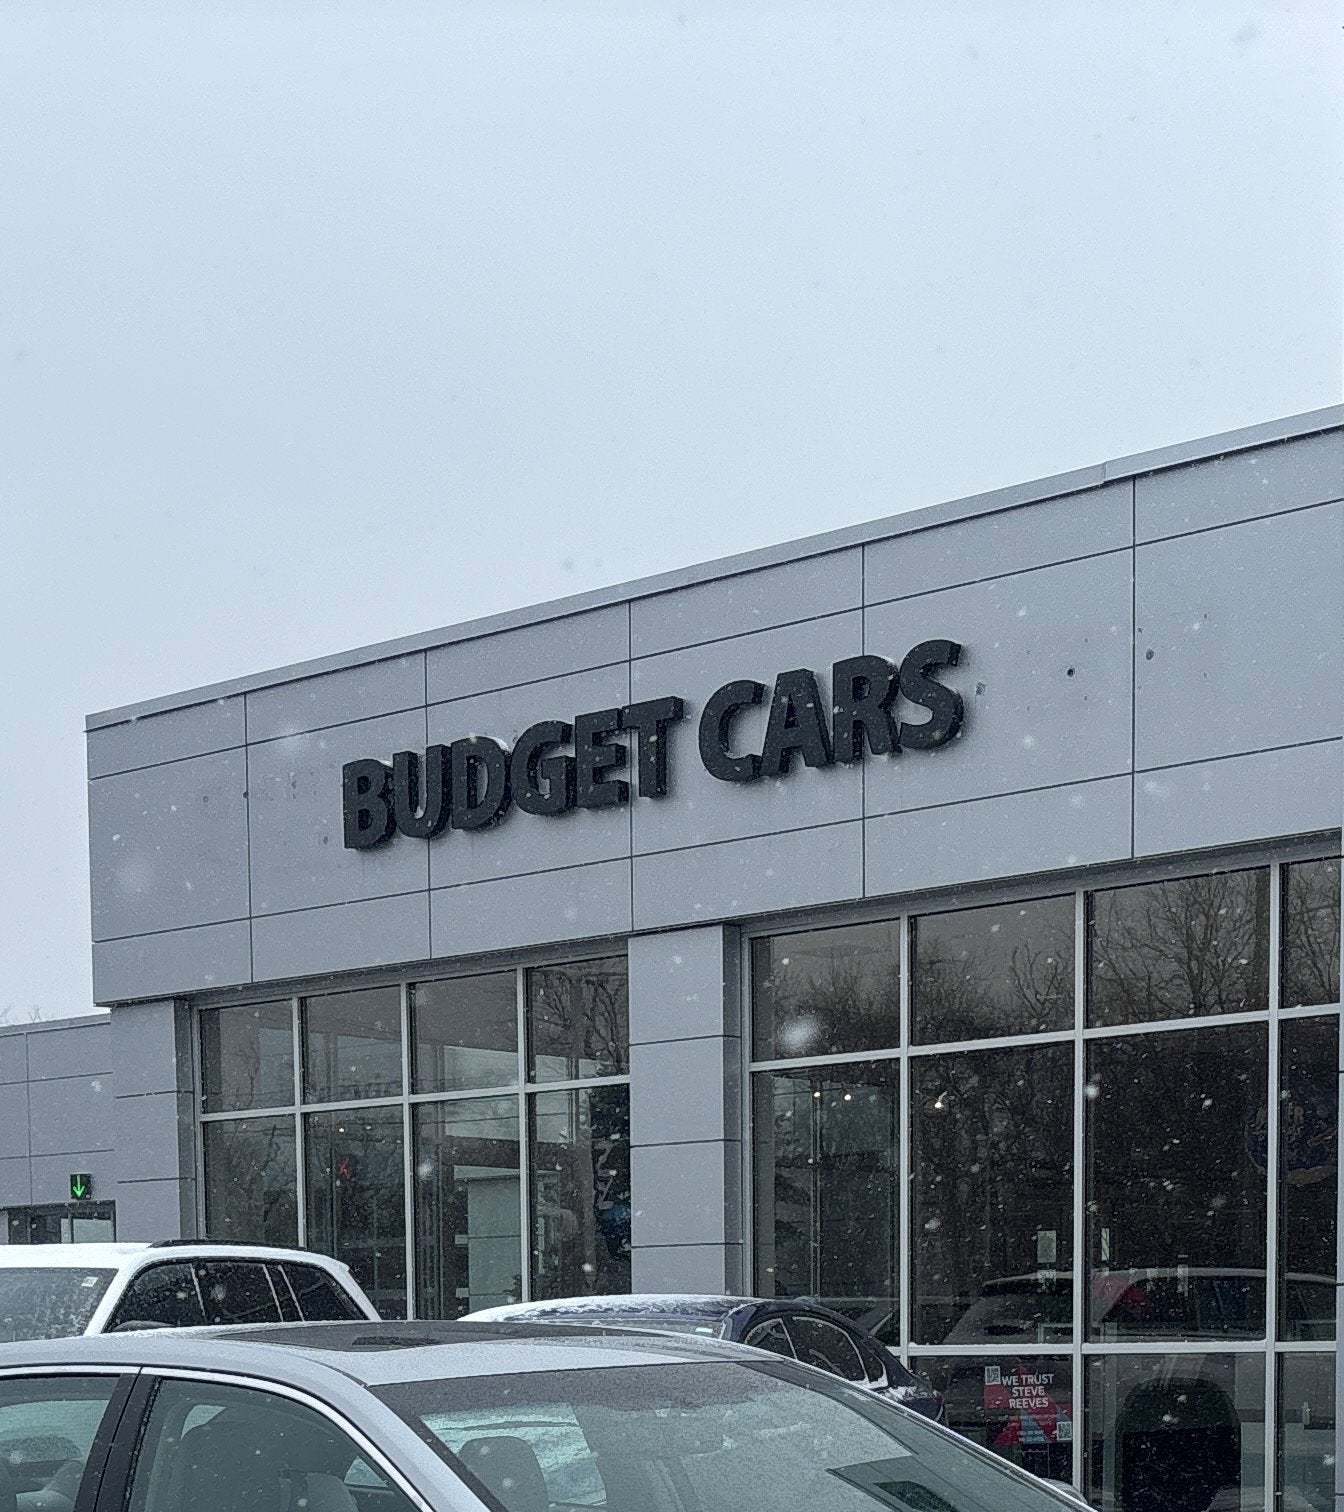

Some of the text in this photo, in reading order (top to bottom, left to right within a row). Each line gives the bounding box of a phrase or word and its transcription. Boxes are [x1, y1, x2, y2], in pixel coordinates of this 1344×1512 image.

[342, 639, 964, 850] BUDGET CARS
[1001, 1373, 1054, 1386] WE TRUST
[1011, 1386, 1045, 1397] STEVE
[1008, 1398, 1049, 1409] REEVES
